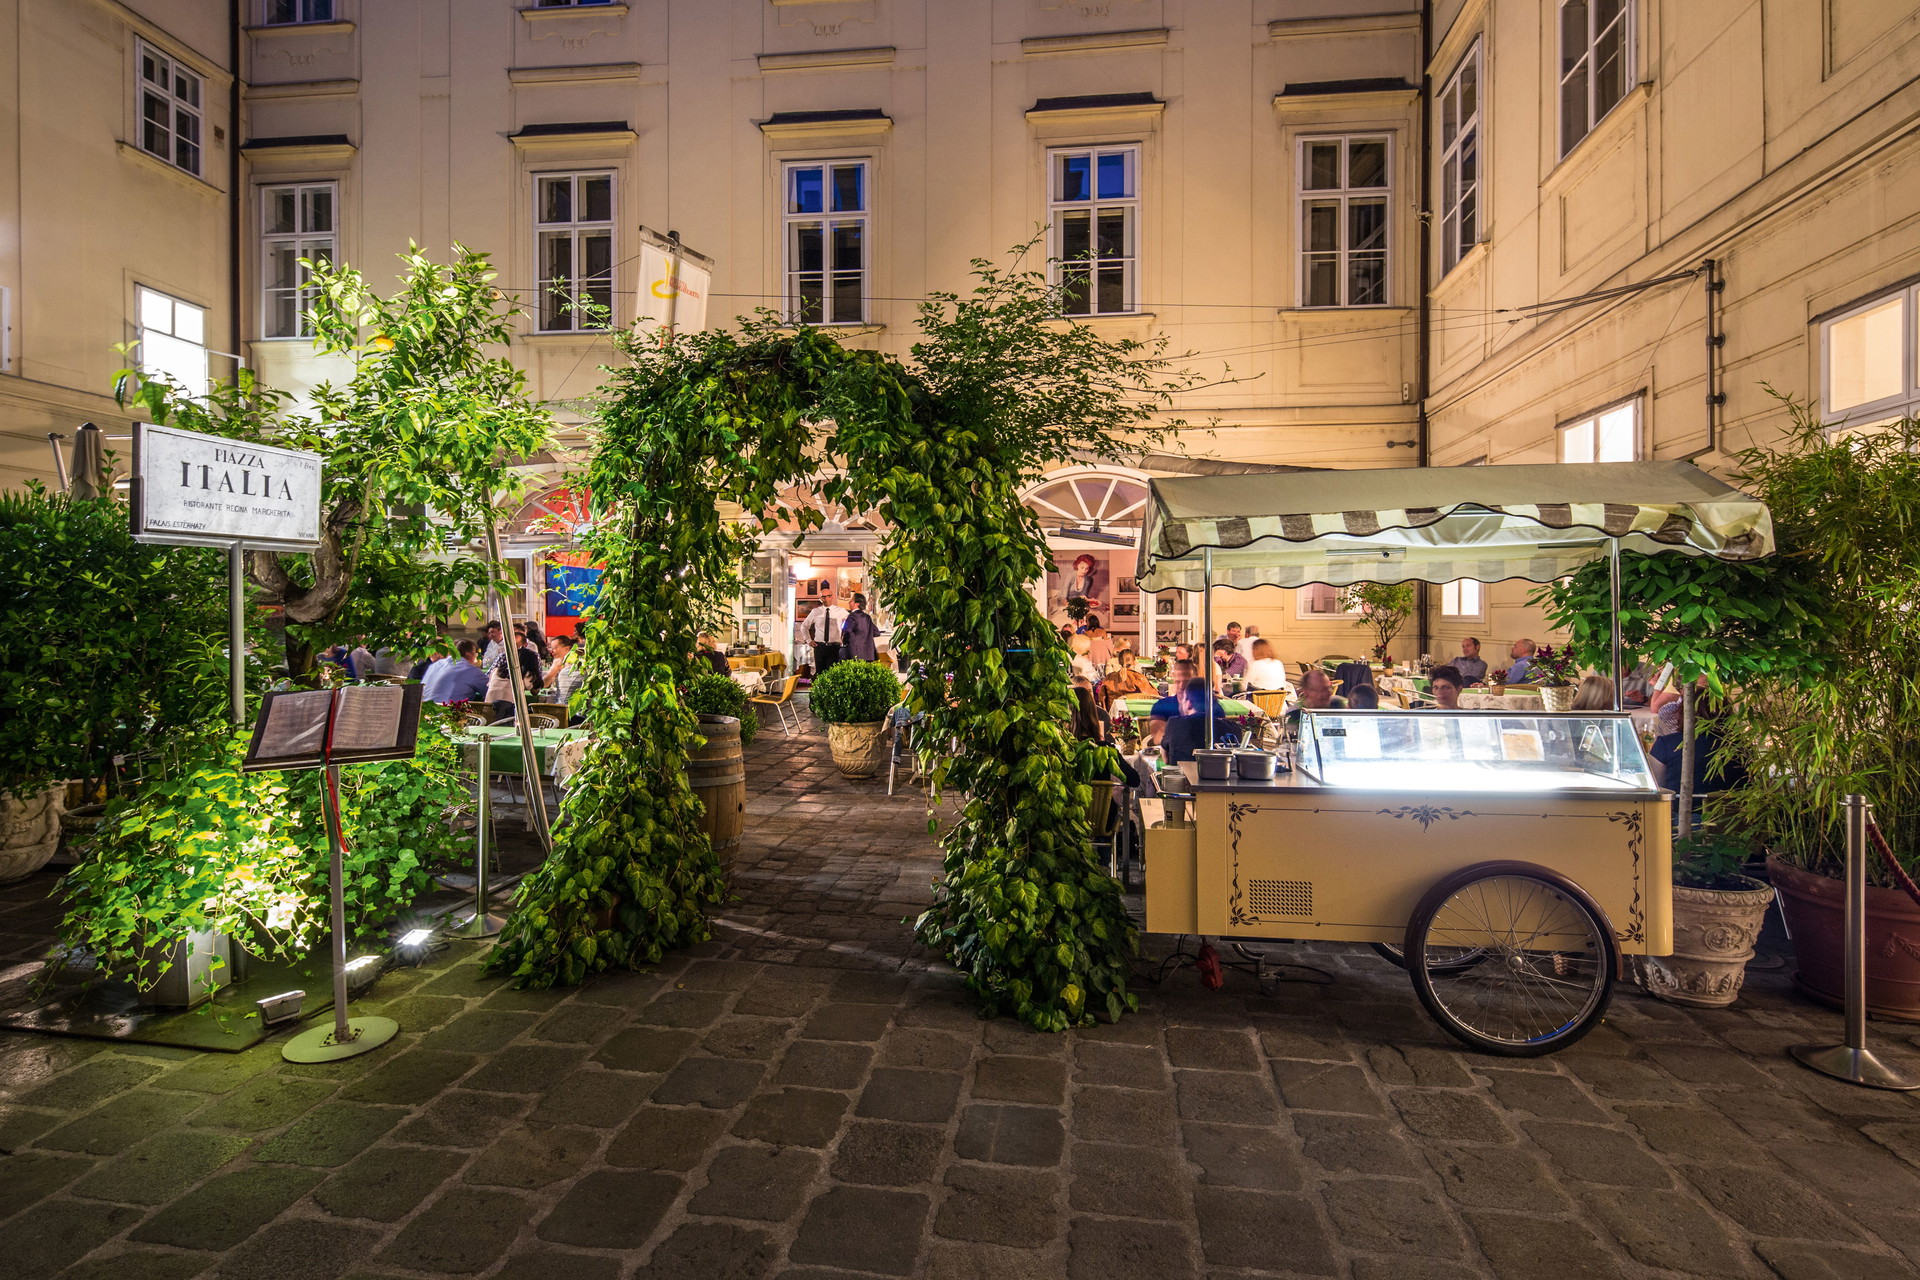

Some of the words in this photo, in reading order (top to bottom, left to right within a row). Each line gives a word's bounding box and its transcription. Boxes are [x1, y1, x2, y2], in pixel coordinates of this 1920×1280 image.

[215, 448, 264, 469] PIAZZA
[180, 460, 293, 501] ITALIA
[183, 499, 222, 511] RISTORANTE
[226, 503, 248, 514] REGINA
[149, 518, 171, 527] PALAIS
